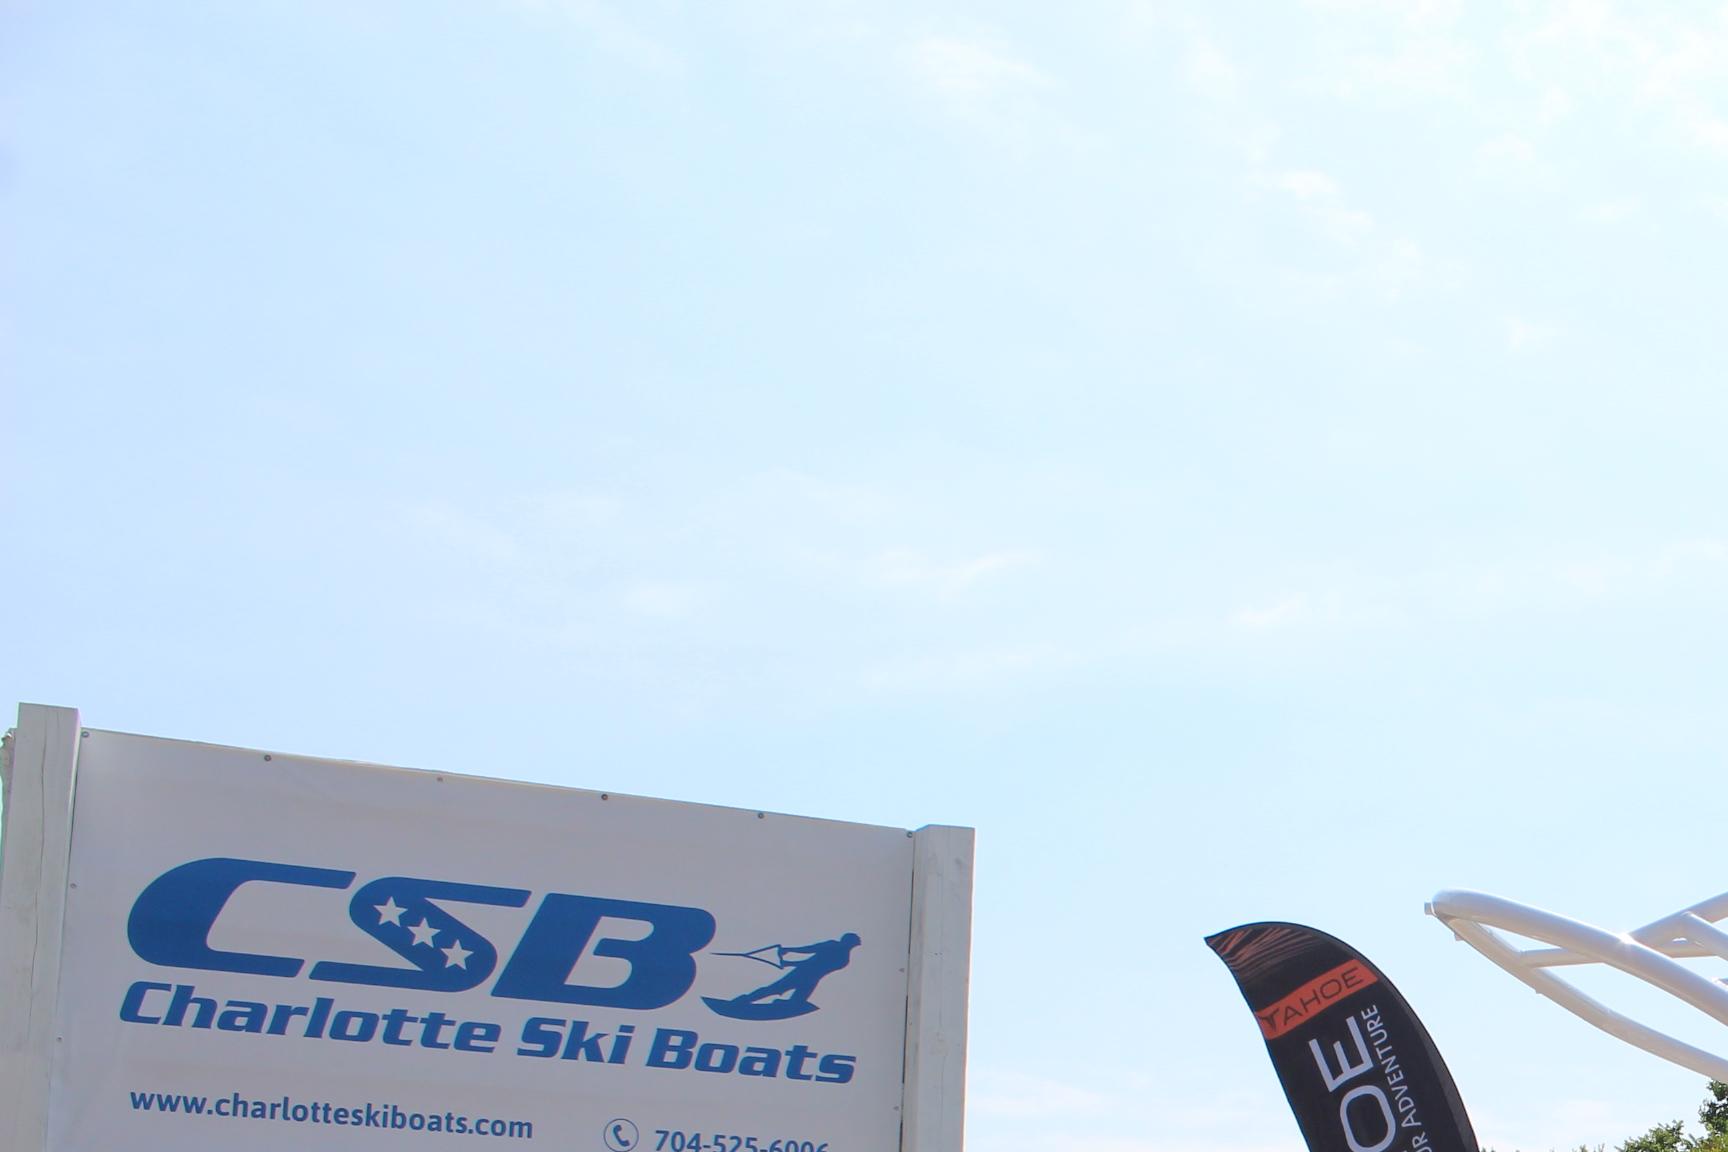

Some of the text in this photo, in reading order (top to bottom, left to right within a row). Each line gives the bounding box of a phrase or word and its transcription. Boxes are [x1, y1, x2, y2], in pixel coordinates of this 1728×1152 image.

[126, 856, 716, 1010] CSB
[118, 980, 855, 1084] Charlotte Ski Boats
[1257, 966, 1363, 1031] TAHOE
[129, 1092, 533, 1138] www.charlotteskiboats.com
[1361, 1004, 1422, 1128] ADVENTURE
